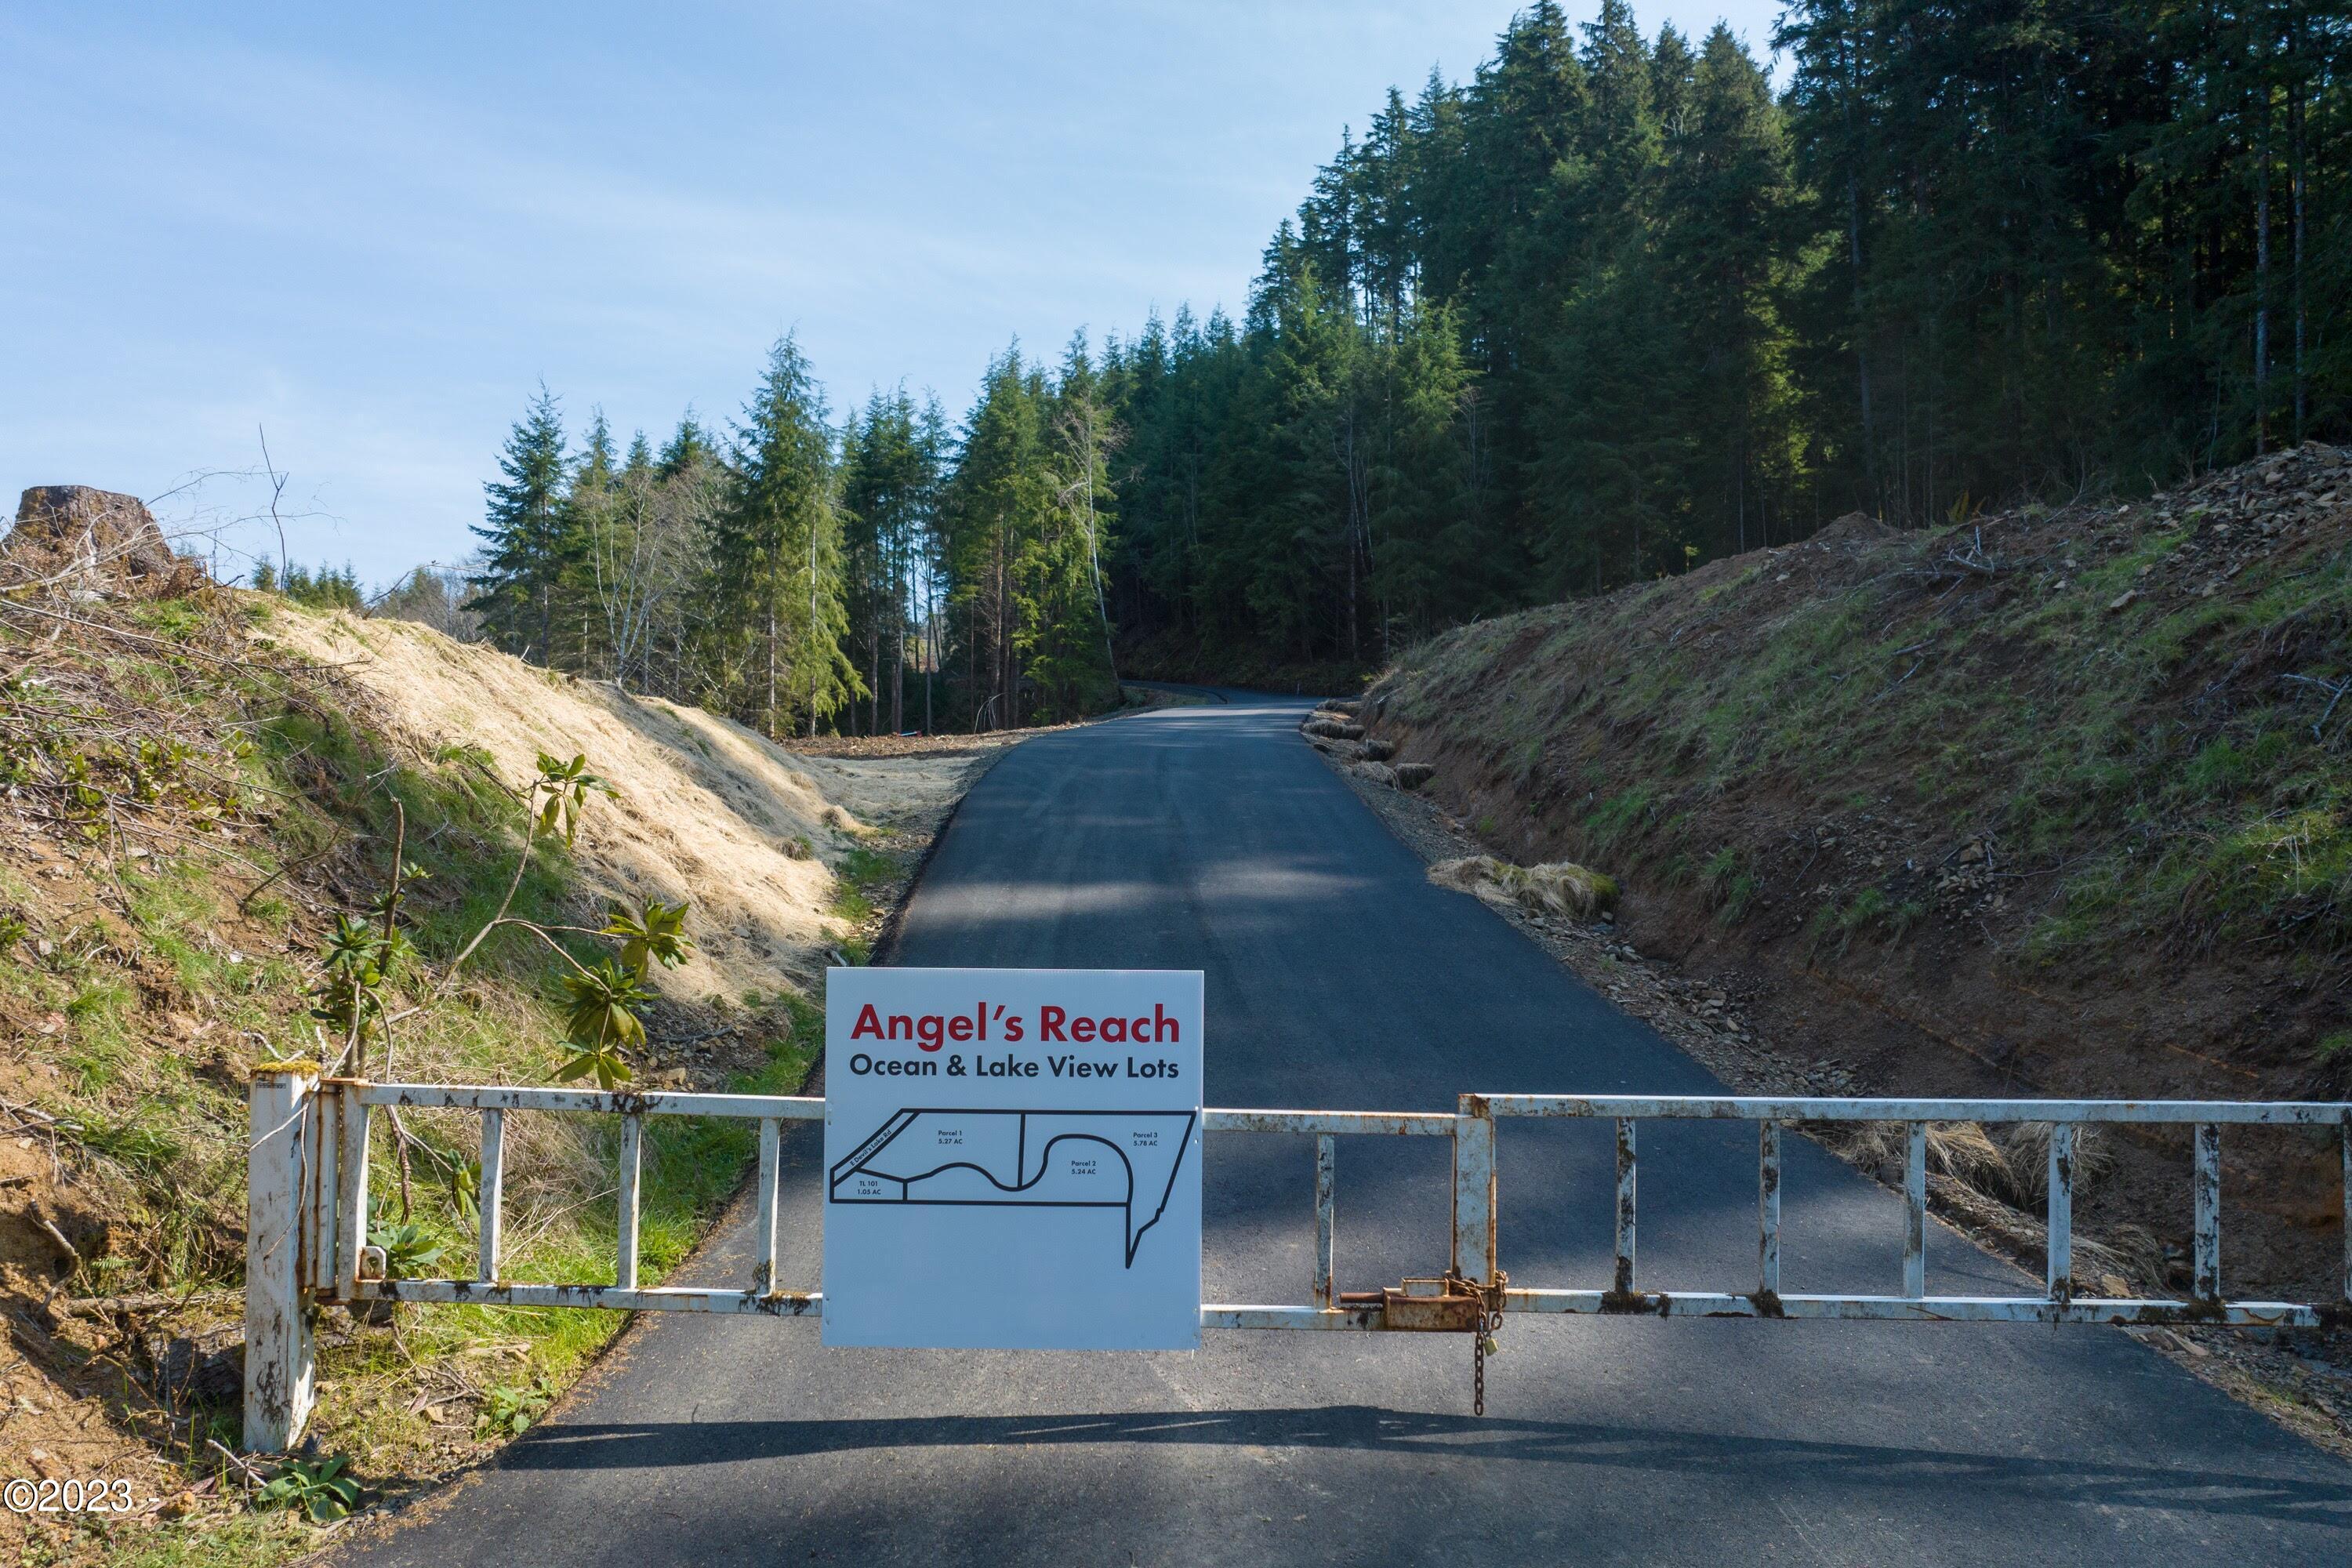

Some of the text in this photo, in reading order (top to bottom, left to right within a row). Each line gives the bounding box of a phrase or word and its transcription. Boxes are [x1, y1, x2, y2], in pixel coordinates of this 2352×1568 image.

[850, 1001, 1180, 1052] Angel's Reach
[849, 1053, 1179, 1079] Ocean & Lake View Lots
[870, 1137, 884, 1149] Lake
[883, 1129, 892, 1138] Rd
